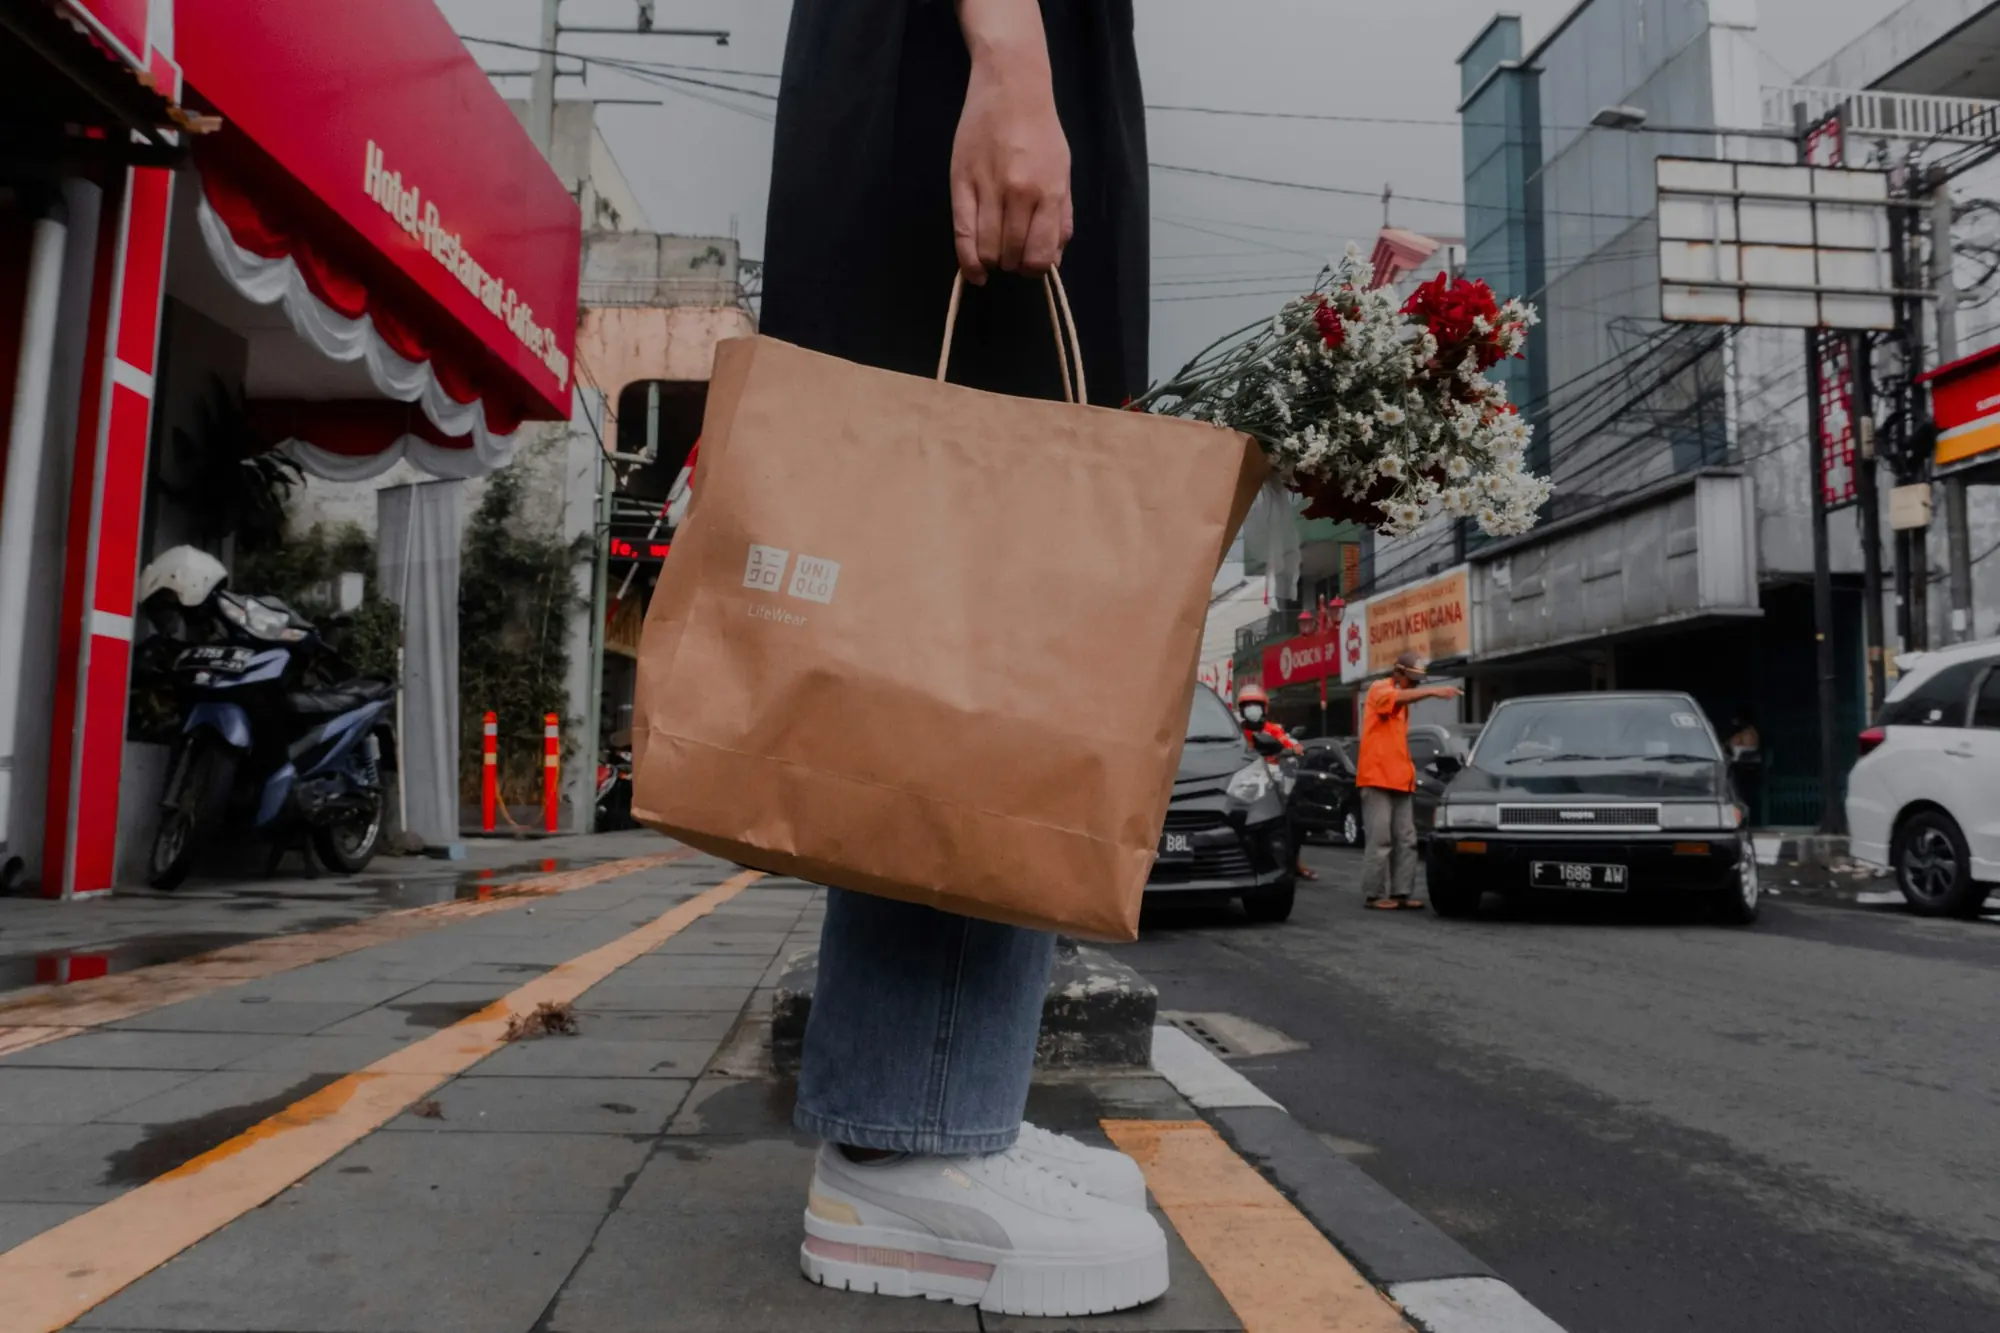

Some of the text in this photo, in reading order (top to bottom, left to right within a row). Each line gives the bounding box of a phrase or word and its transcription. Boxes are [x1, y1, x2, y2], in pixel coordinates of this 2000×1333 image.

[800, 561, 831, 580] UNI
[796, 577, 829, 597] QLO
[747, 603, 808, 627] LifeWear
[1370, 601, 1463, 645] SURYA KENCANA
[1534, 862, 1544, 879] F
[1603, 866, 1624, 883] AW
